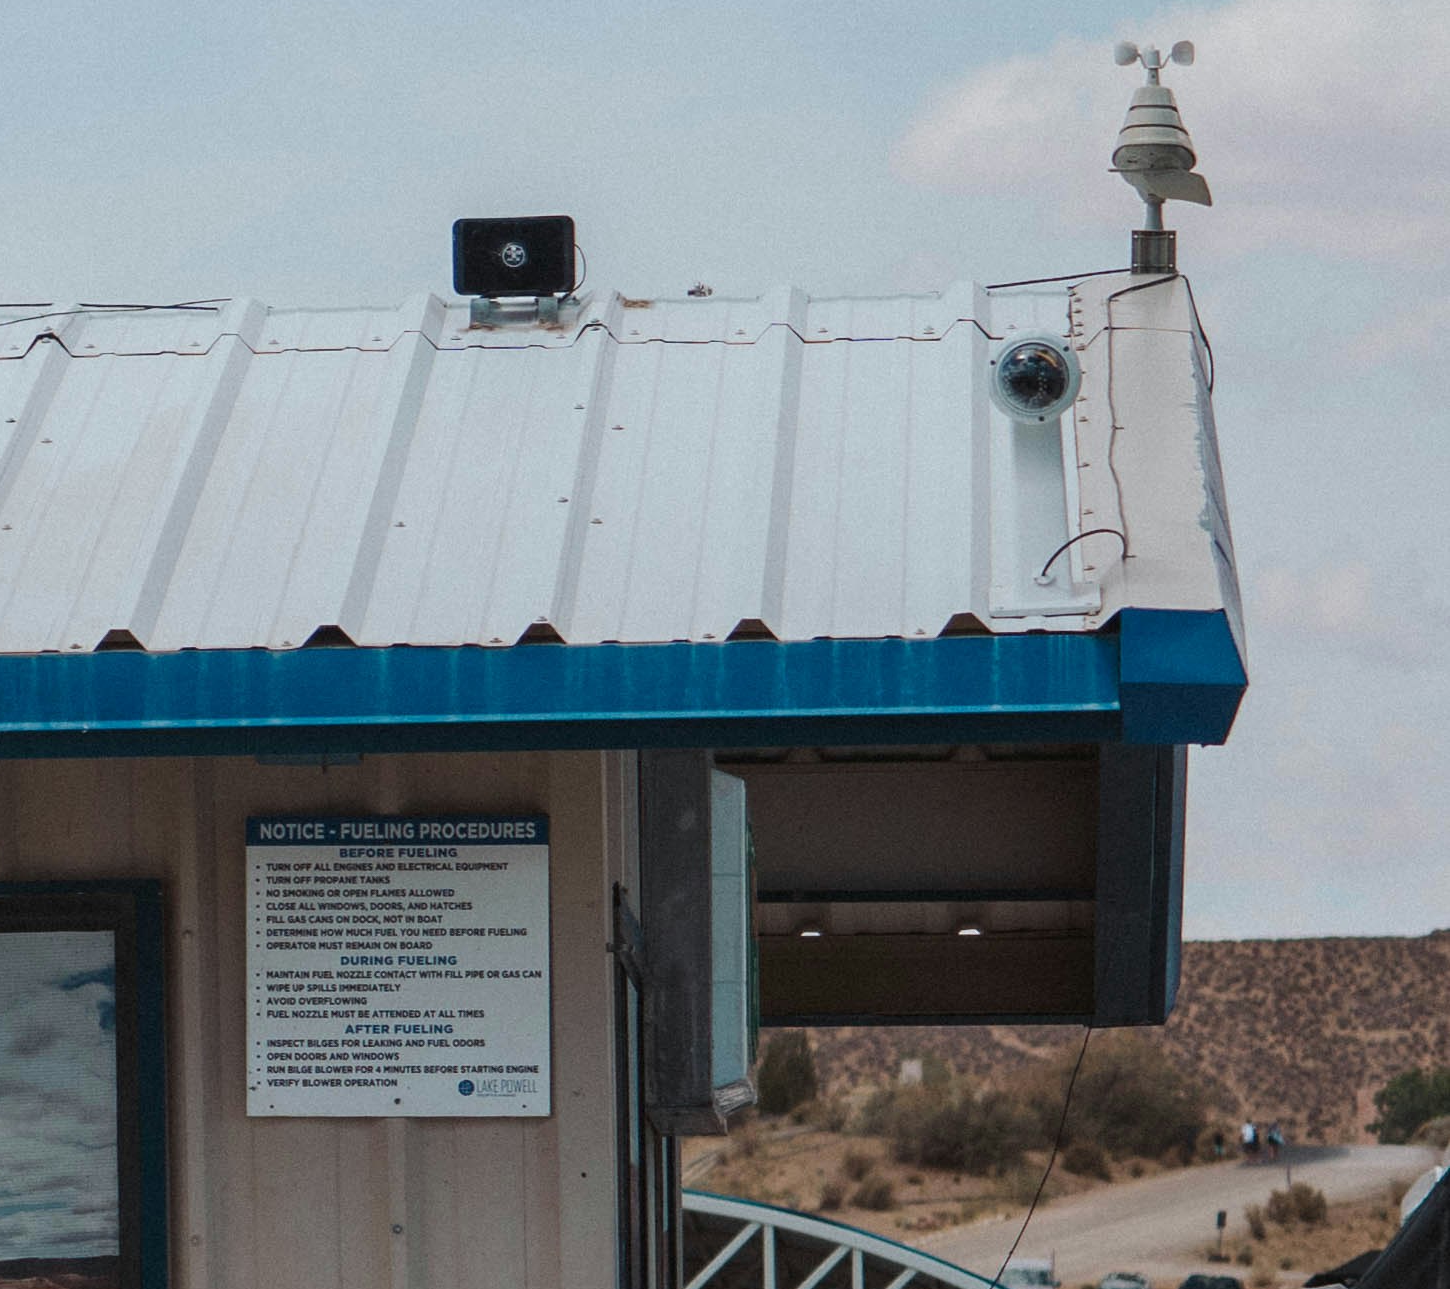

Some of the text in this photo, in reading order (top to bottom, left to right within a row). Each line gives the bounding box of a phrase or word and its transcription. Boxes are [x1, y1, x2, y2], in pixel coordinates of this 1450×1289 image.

[260, 822, 536, 839] NOTICE FUELING PROCEDURES
[339, 848, 458, 858] BEFORE FUELING
[266, 862, 508, 872] TURN OFF ALL ENGINES AND ELECTRICAL EQUIPMENT
[266, 876, 390, 884] TURN PROPANE TANKS
[282, 889, 455, 898] SMOKING OPEN FLAMES ALLOWED
[266, 902, 473, 911] CLOSE ALL AND HATCHES
[266, 914, 443, 924] FILL GAS CANS NOT BOAT
[266, 928, 527, 937] DETERMINE HOW MUCH FUEL YOU NEED BEFORE FUELING
[266, 941, 433, 950] OPERATOR MUST REMAIN BOARD
[340, 956, 457, 966] DURING FUELING
[266, 970, 542, 979] MAINTAIN FUEL NOZZLE CONTACT WITH FILL PIPE GAS CAN
[266, 983, 401, 992] WIPE SPILLS IMMEDIATELY
[266, 997, 368, 1006] AVOID OVERFLOWING
[266, 1010, 485, 1018] FUEL NOZZLE MUST ATTENDED ALL TIMES
[345, 1024, 454, 1034] AFTER FUELING
[267, 1039, 486, 1048] INSPECT BILGES FOR LEAKING AND FUEL ODORS
[266, 1052, 400, 1061] OPEN DOORS AND WINDOWS
[266, 1065, 539, 1074] RUN BILGE BLOWER FOR MINUTES BEFORE STARTING ENGINE
[266, 1078, 398, 1087] VERIFY BLOWER OPERATION
[476, 1079, 538, 1094] LAKE POWELL
